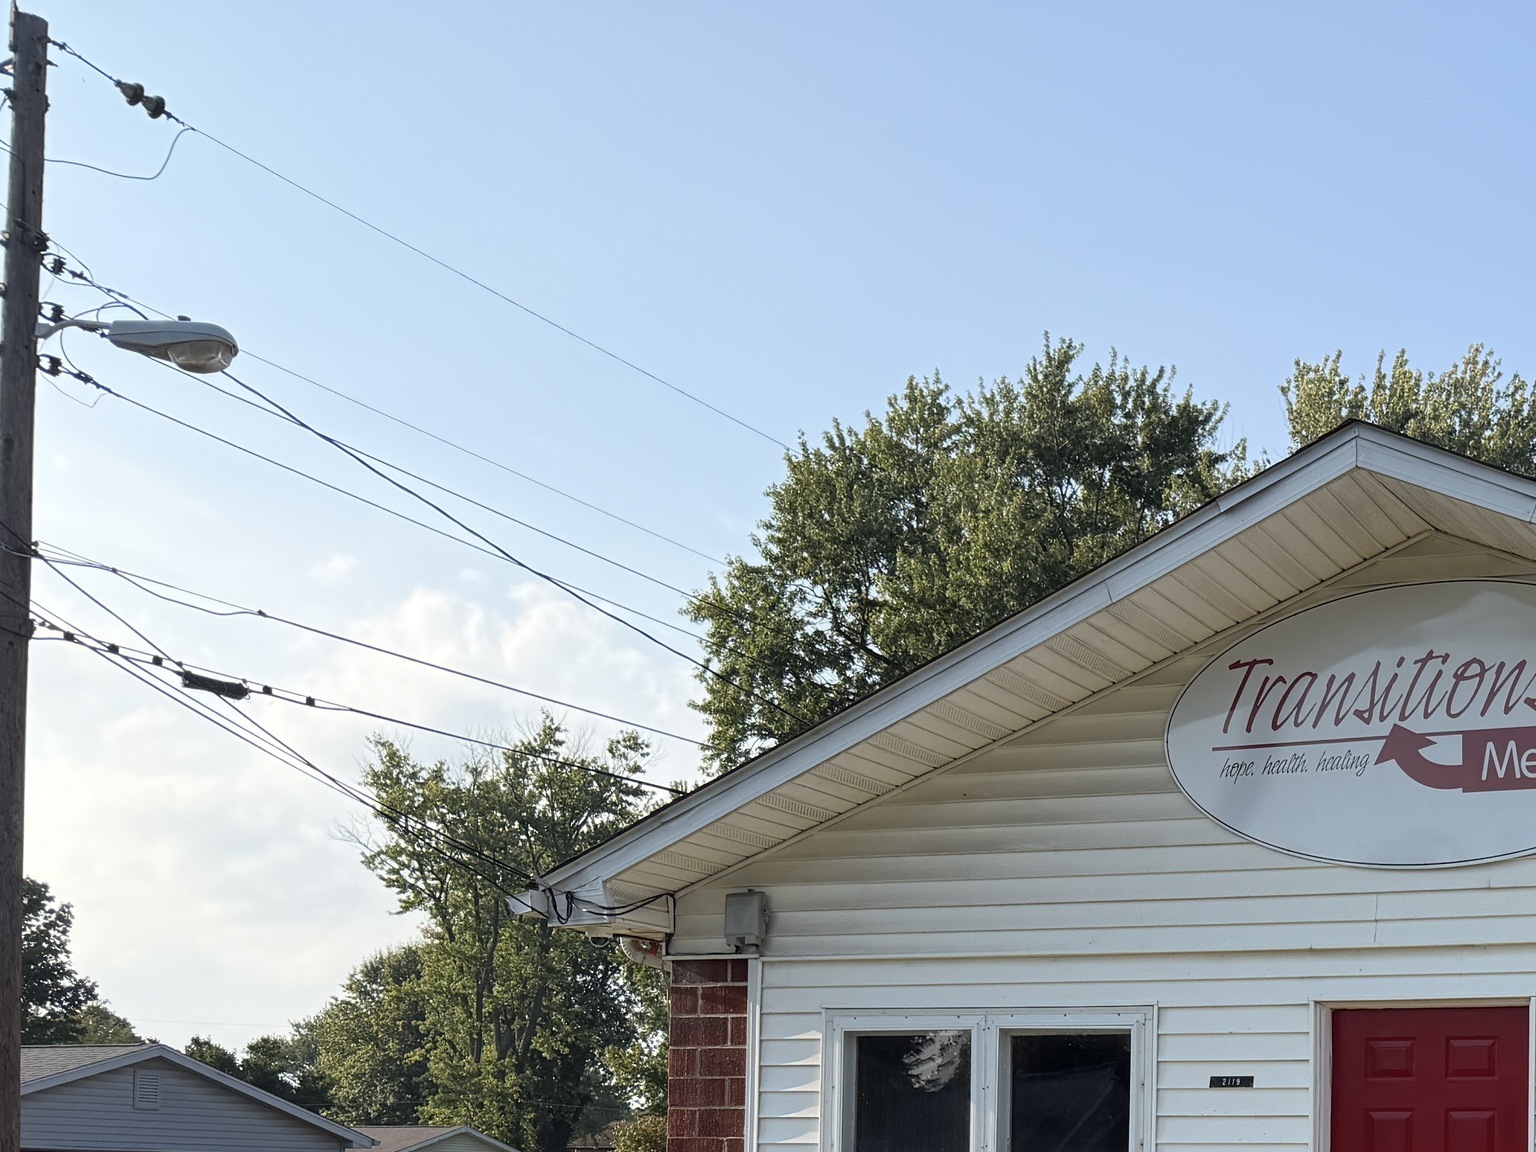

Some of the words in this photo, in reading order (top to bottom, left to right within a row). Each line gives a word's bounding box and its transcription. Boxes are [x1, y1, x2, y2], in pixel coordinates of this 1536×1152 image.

[1219, 757, 1254, 784] hope.
[1261, 754, 1308, 776] health.
[1315, 749, 1370, 777] healing
